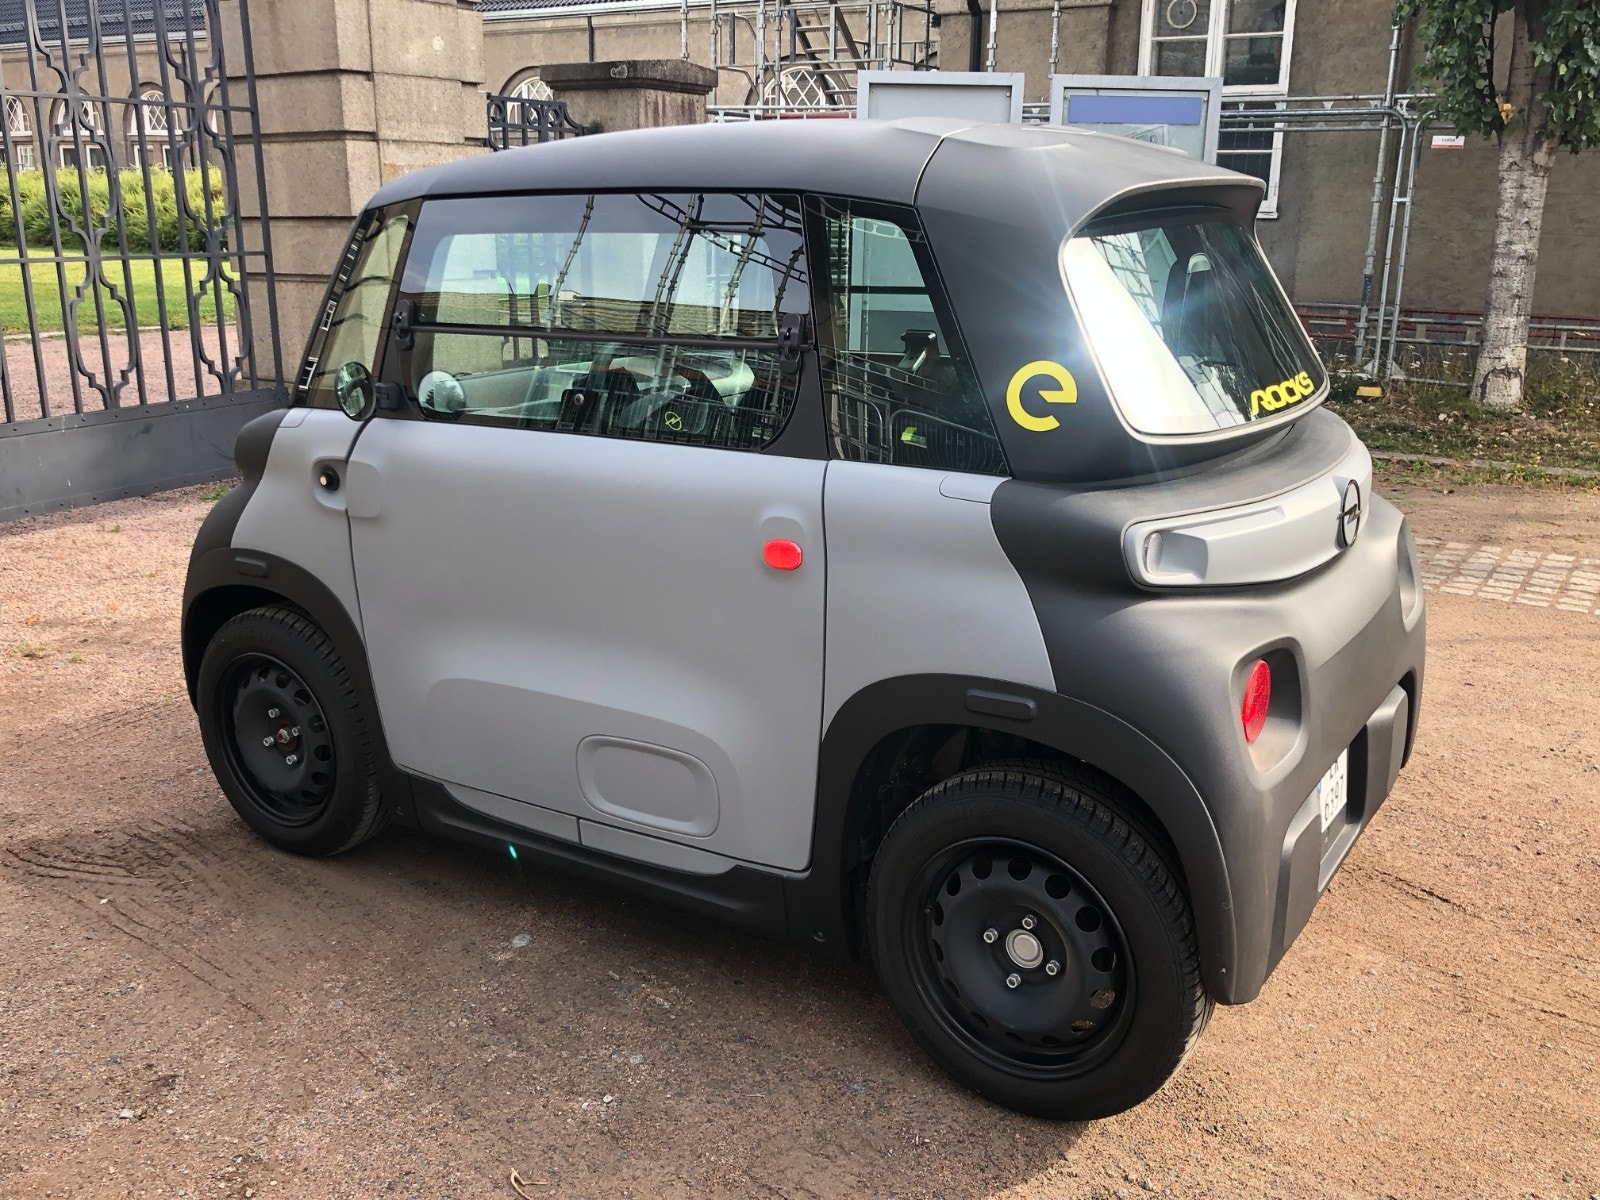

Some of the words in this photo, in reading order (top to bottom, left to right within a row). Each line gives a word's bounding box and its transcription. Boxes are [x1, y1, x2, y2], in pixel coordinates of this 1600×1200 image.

[1006, 360, 1078, 432] e
[1251, 371, 1315, 416] ROCKS
[1324, 774, 1344, 821] 6397
